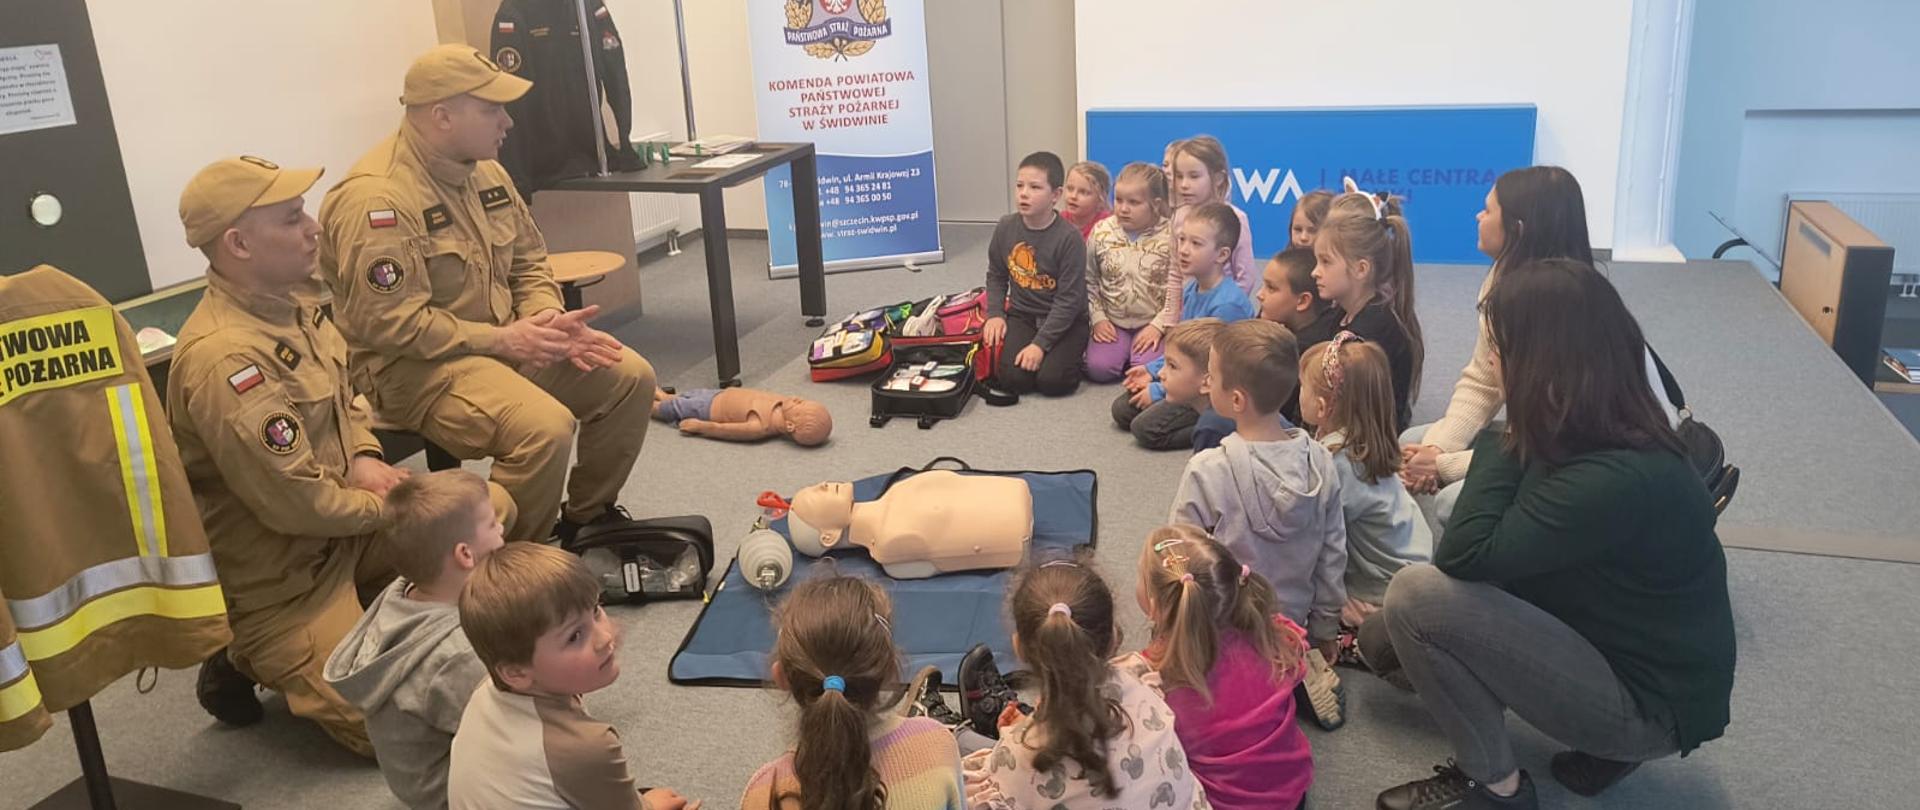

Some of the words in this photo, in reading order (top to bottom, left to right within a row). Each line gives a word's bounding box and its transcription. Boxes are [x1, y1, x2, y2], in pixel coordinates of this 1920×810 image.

[787, 27, 828, 42] PAŃSTWOWA
[829, 21, 849, 33] STRAŻ
[853, 24, 888, 37] POŻARNA
[768, 76, 833, 92] KOMENDA
[837, 70, 915, 86] POWIATOWA
[800, 85, 886, 103] PAŃSTWOWEJ
[788, 104, 834, 118] STRAŻY
[838, 99, 900, 115] POŻARNEJ
[802, 121, 816, 131] W
[819, 113, 889, 130] ŚWIDWINIE
[854, 171, 875, 182] Armii
[876, 168, 910, 181] Krajowej
[910, 167, 921, 177] 23
[844, 184, 854, 194] 94
[855, 182, 870, 193] 365
[871, 182, 880, 191] 24
[1233, 168, 1303, 204] WA
[1406, 167, 1497, 187] CENTRA
[844, 195, 854, 205] 94
[855, 194, 870, 204] 365
[871, 192, 881, 202] 00
[882, 192, 892, 201] 50
